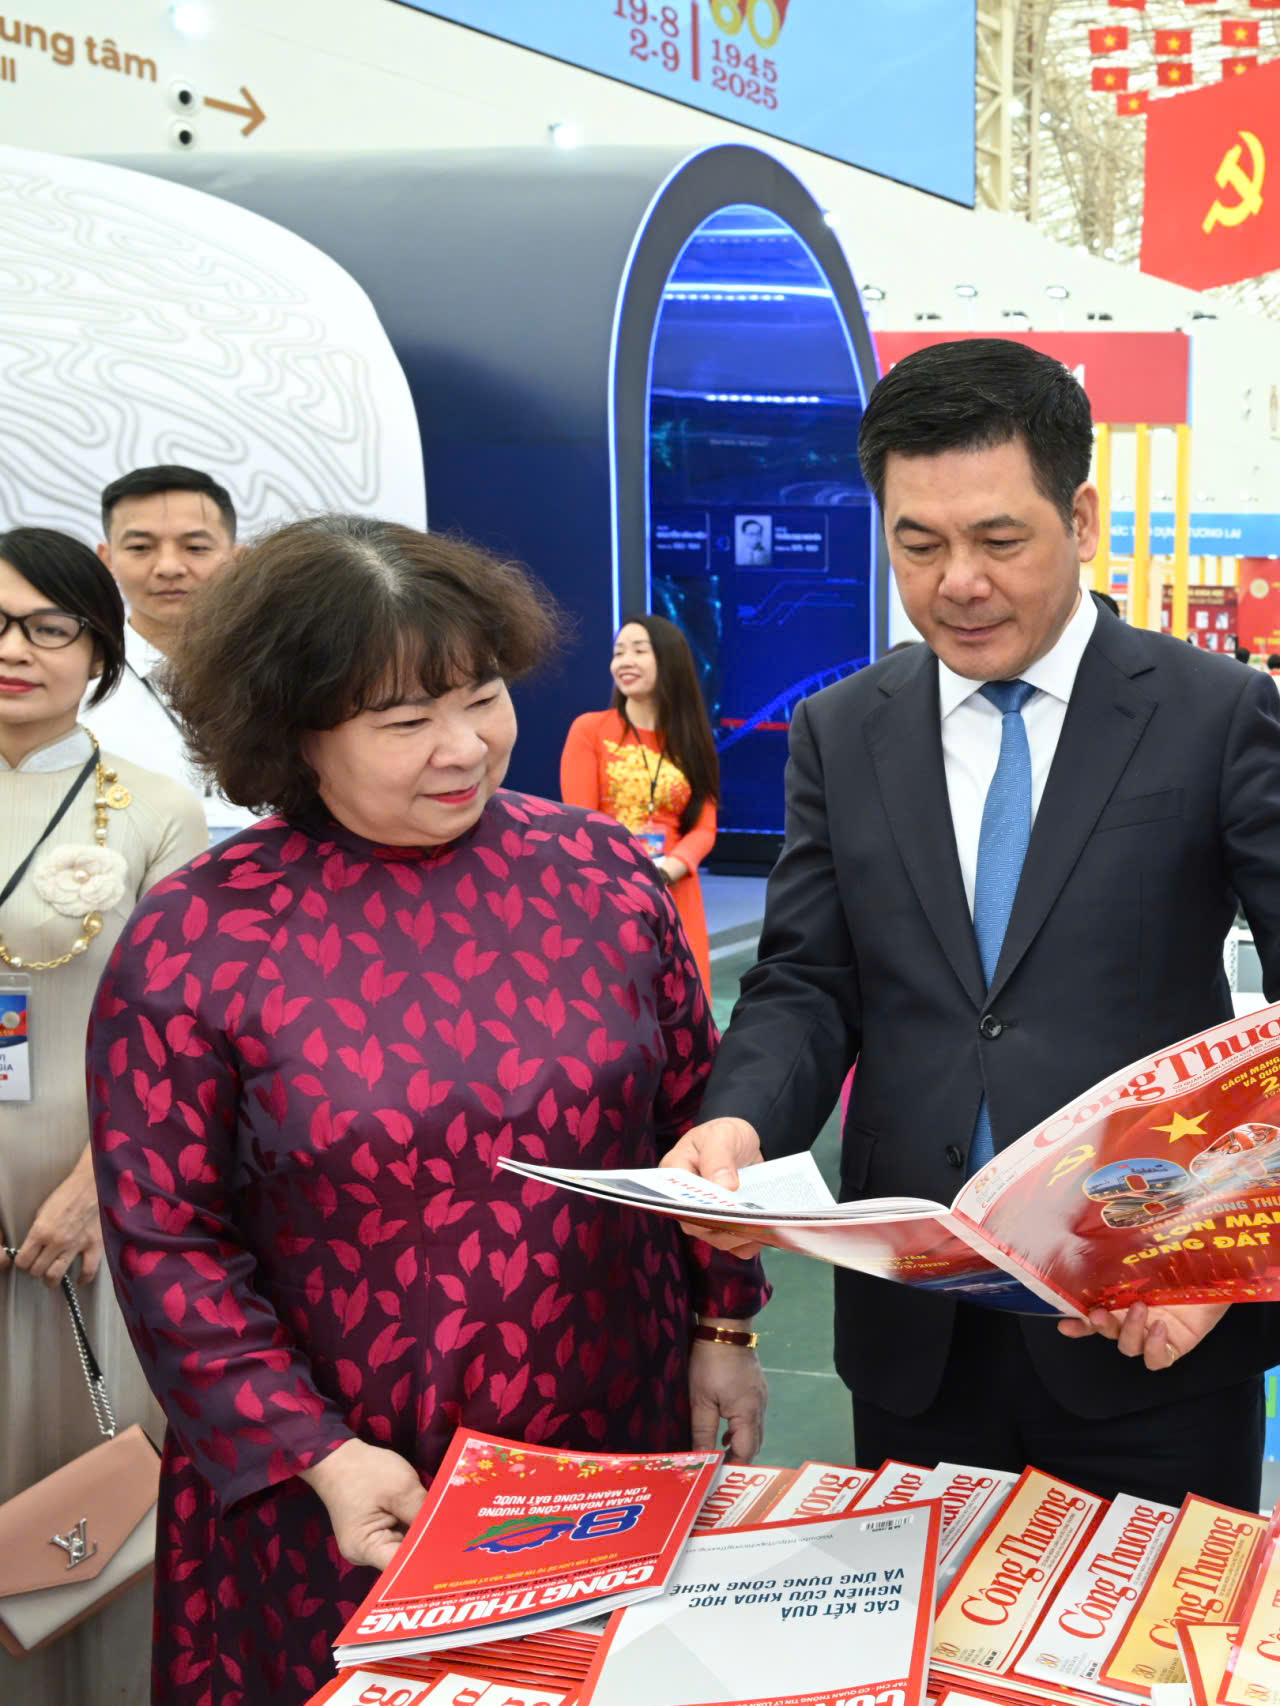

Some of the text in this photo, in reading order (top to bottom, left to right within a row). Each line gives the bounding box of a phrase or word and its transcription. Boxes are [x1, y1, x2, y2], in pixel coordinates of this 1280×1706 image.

[85, 36, 157, 82] tâm
[712, 39, 777, 83] 1945
[712, 65, 778, 110] 2025
[1221, 1073, 1248, 1091] CÁCH
[1249, 1056, 1280, 1075] MẠNG
[1243, 1075, 1257, 1088] VÀ
[1201, 1199, 1250, 1216] CÔNG
[1212, 1230, 1271, 1249] ĐẤT
[493, 1487, 648, 1505] LỚN MẠNH CÙNG ĐẤT NƯỚC
[563, 1499, 606, 1512] NGÀNH
[607, 1496, 633, 1506] NĂM
[478, 1506, 525, 1517] THƯƠNG
[528, 1504, 561, 1516] CÔNG
[996, 1488, 1086, 1564] Thương
[1088, 1504, 1175, 1583] Thương
[1172, 1516, 1254, 1594] Thương
[669, 1568, 904, 1596] VÀ ỨNG DỤNG CÔNG NGHỆ
[961, 1558, 1045, 1626] Công
[356, 1565, 655, 1634] CÔNG THƯƠNG
[688, 1585, 902, 1608] NGHIÊN CỨU KHOA HỌC
[1058, 1577, 1138, 1639] Công
[781, 1600, 899, 1621] CÁC KẾT QUẢ
[801, 1694, 831, 1704] THÔNG
[832, 1689, 856, 1698] QUAN
